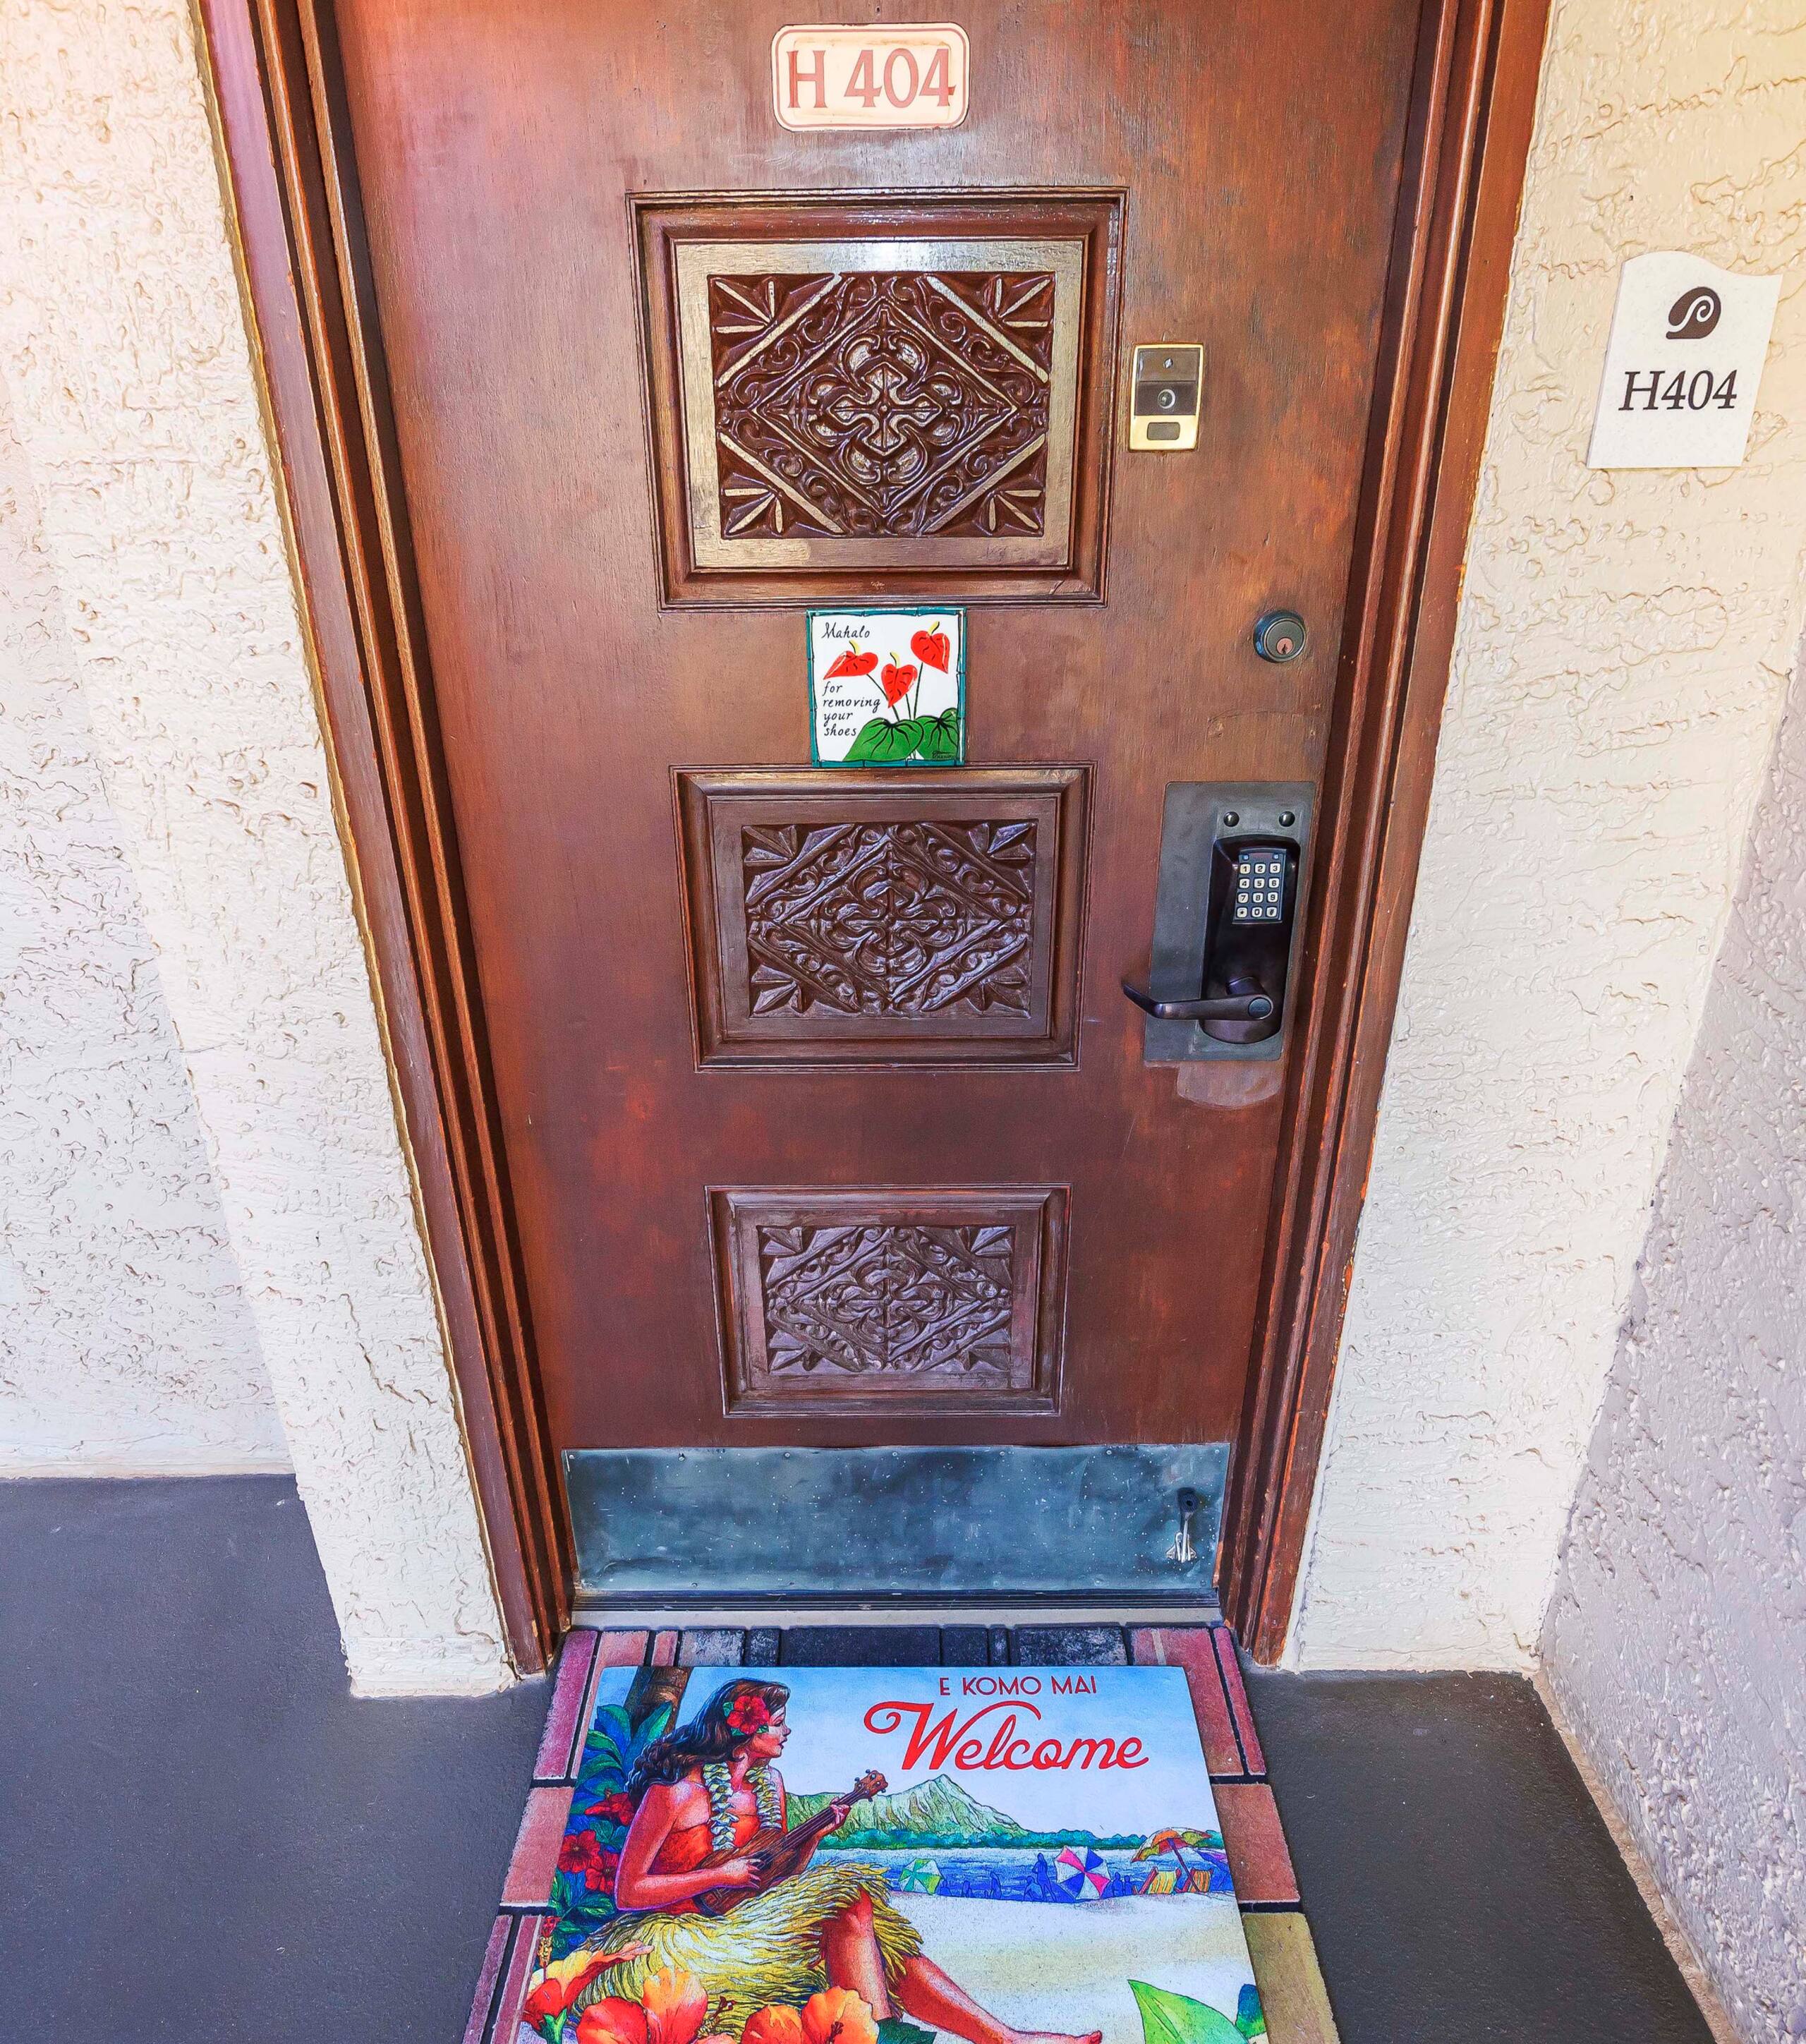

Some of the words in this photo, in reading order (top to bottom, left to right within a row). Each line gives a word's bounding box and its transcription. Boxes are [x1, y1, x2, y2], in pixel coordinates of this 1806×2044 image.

[787, 50, 828, 108] H
[844, 48, 957, 108] 404
[1618, 369, 1738, 411] H404
[821, 622, 871, 639] Mahalo
[822, 682, 843, 696] for
[823, 697, 881, 713] removing
[824, 711, 853, 727] your
[824, 724, 856, 736] shoes
[939, 1676, 951, 1696] E
[962, 1676, 1042, 1696] KOMO
[1051, 1675, 1098, 1695] MAI
[863, 1700, 1150, 1771] Welcome
